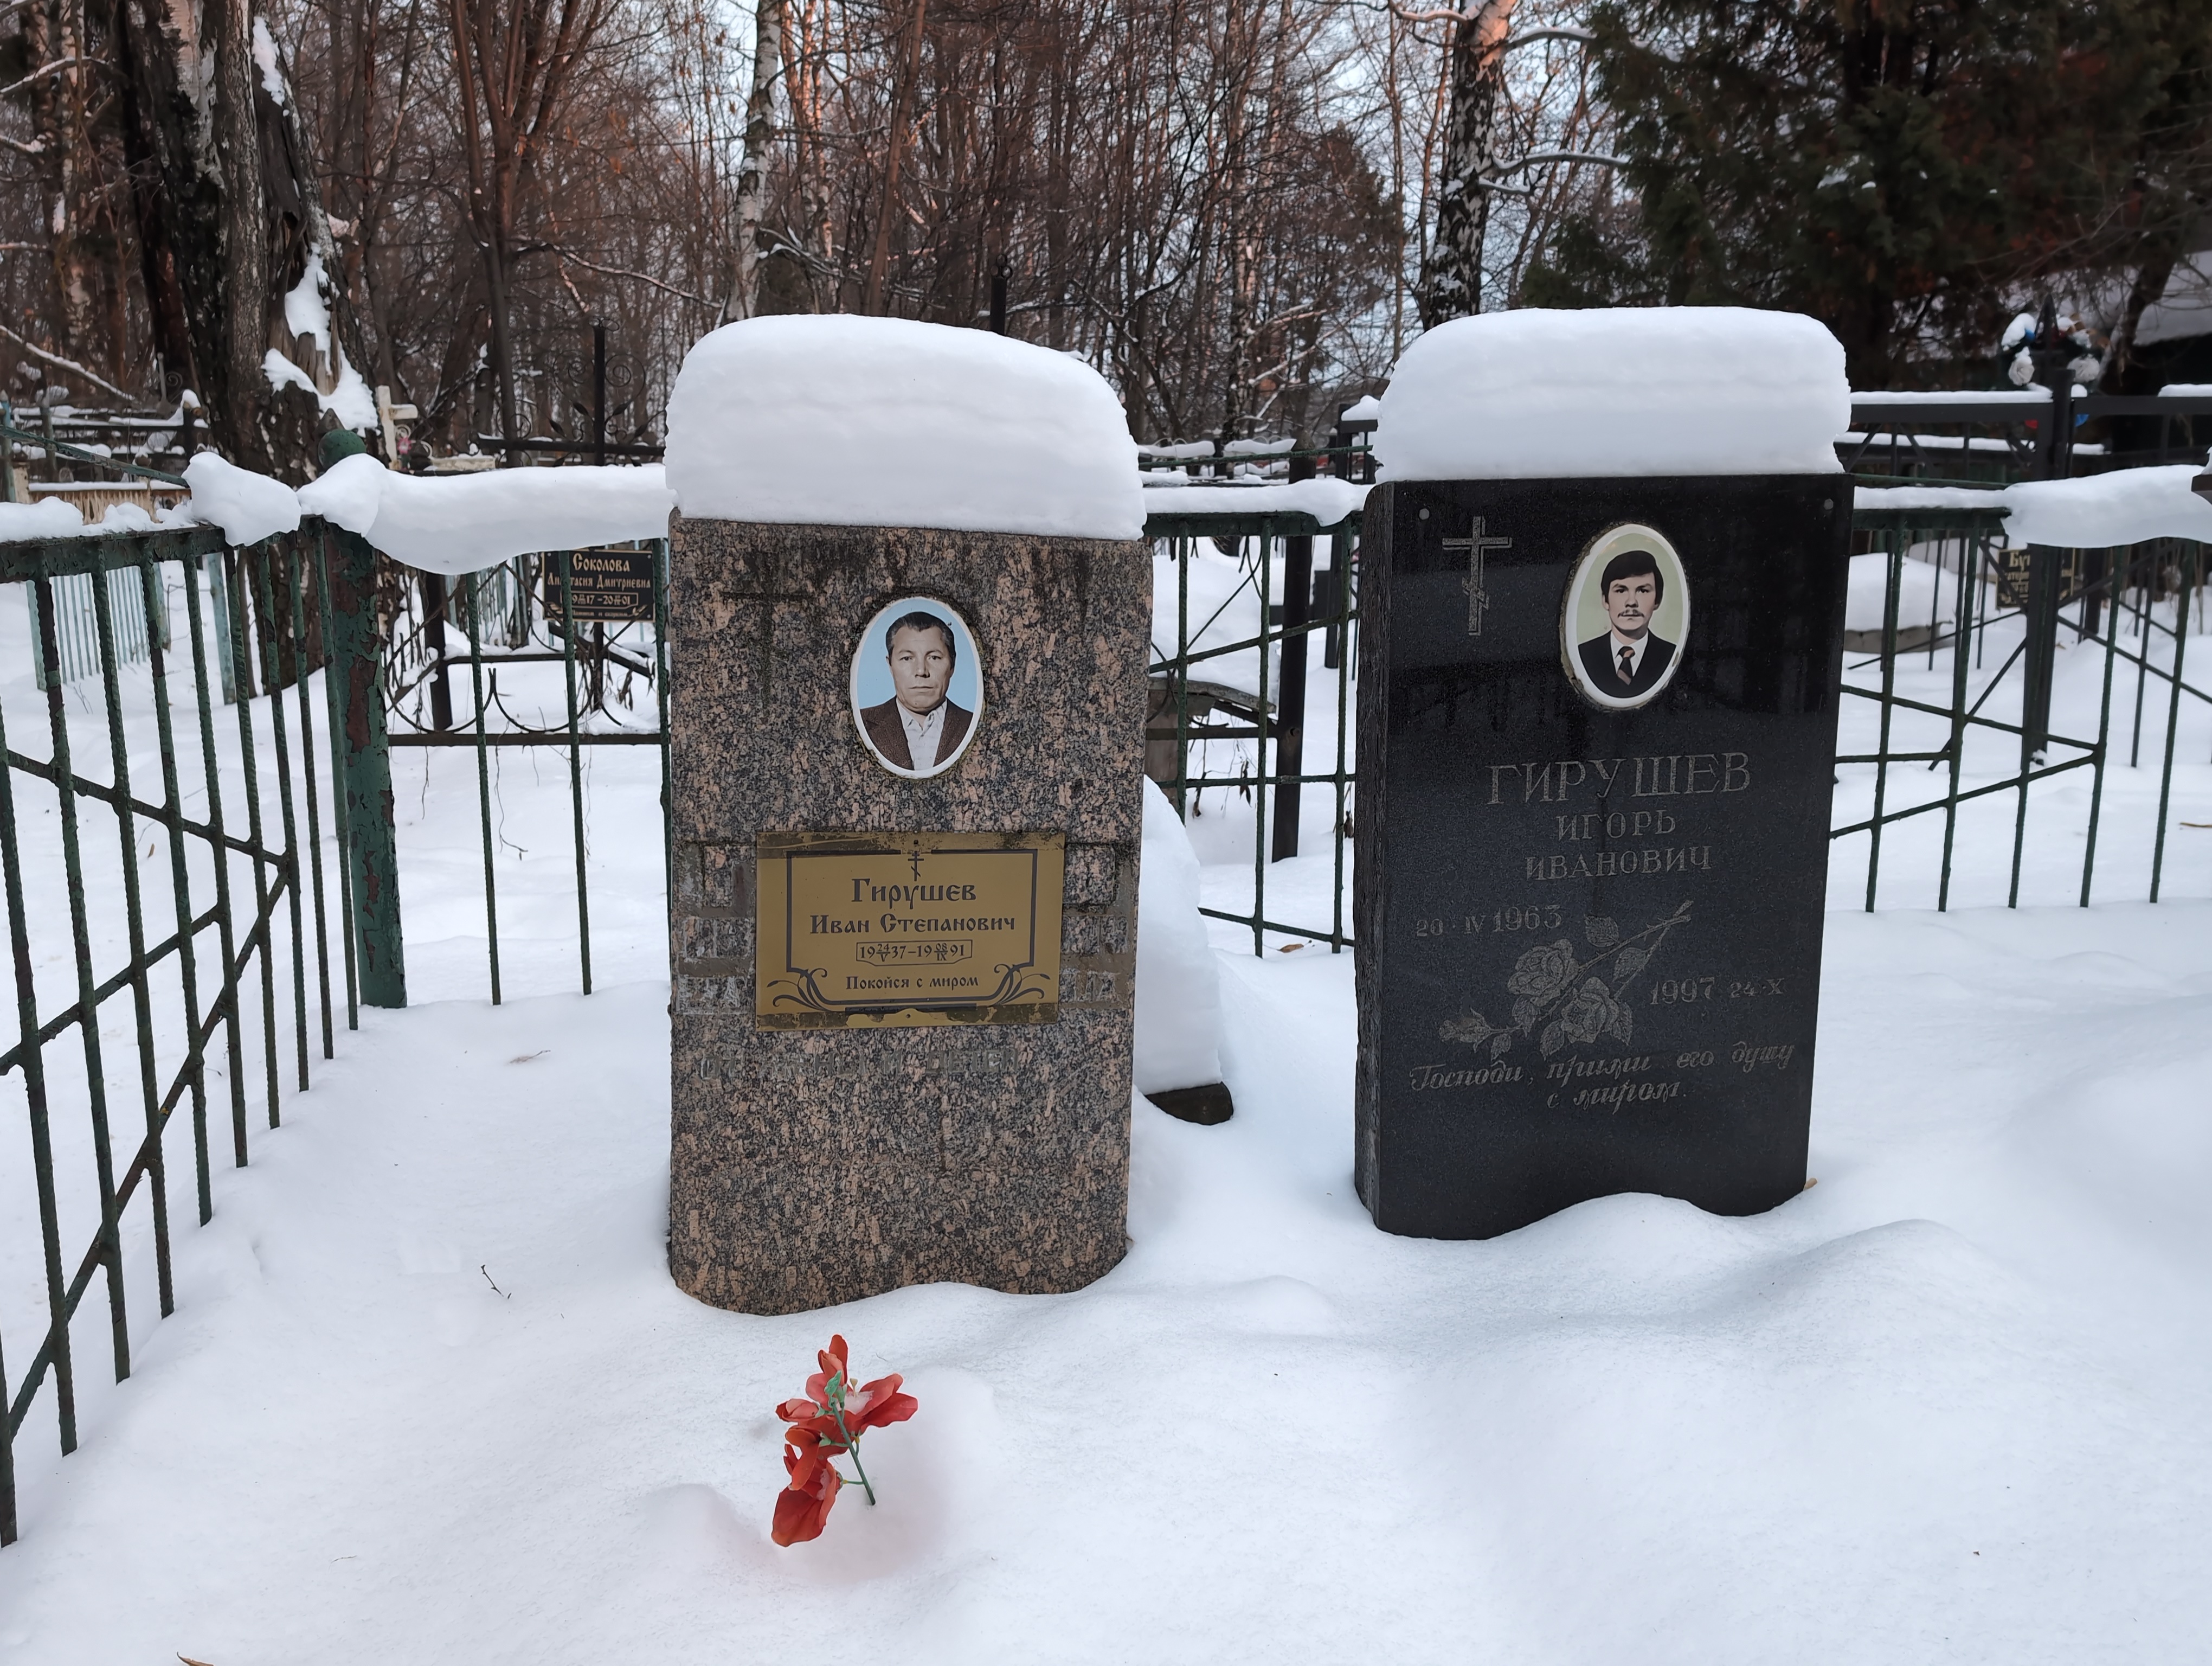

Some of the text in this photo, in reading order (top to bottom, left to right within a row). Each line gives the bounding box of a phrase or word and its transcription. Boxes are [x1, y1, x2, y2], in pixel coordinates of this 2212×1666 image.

[573, 553, 630, 572] Соколова
[548, 572, 651, 591] Антасия Дмитриевна
[1485, 752, 1751, 804] ГИРУШЕВ
[1556, 809, 1676, 841] ИГОРЬ
[1525, 846, 1712, 880] ИВАНОВИЧ
[851, 878, 976, 909] Гирушев
[810, 913, 1015, 934] Иван Степанович
[1492, 905, 1562, 932] 1963
[846, 976, 979, 990] Покойся с миром
[1650, 977, 1715, 1005] 1997
[1546, 1054, 1651, 1087] прими
[1676, 1050, 1714, 1069] его
[1732, 1041, 1795, 1073] душу
[1547, 1091, 1559, 1108] с
